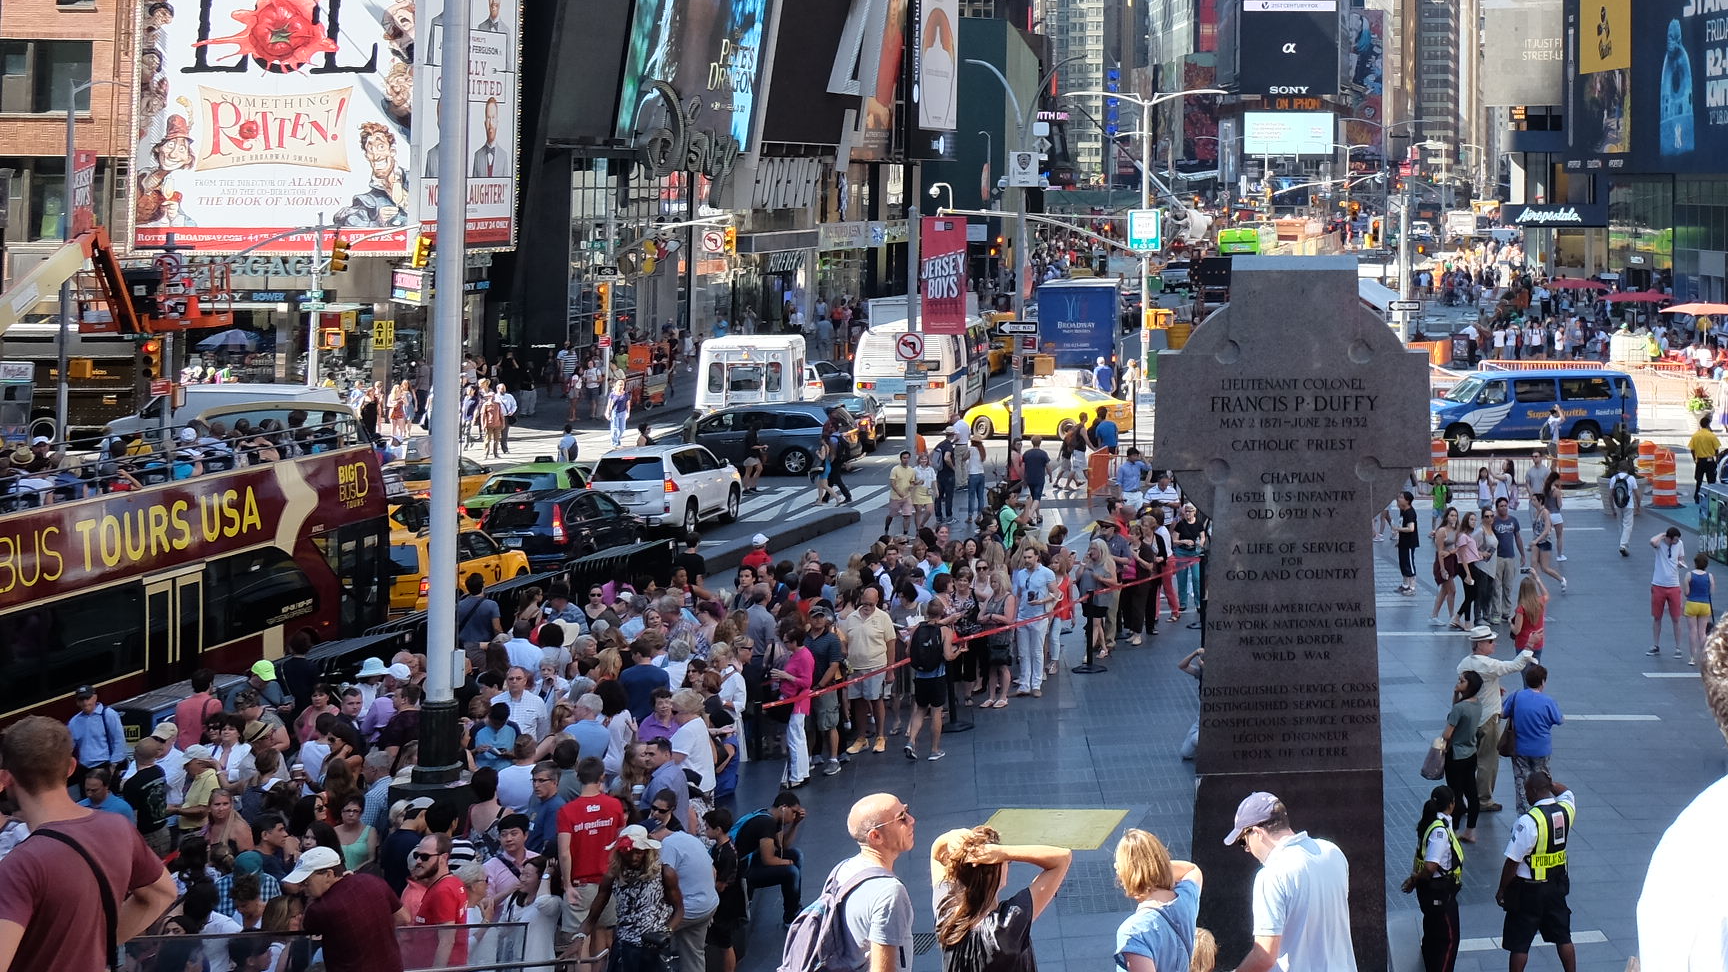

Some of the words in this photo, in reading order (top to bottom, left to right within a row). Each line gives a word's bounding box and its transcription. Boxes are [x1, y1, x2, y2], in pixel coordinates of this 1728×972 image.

[1270, 86, 1309, 94] SONY
[221, 93, 329, 107] SOMETHING
[288, 177, 344, 187] ALADDIN
[197, 197, 223, 206] THE
[227, 196, 263, 206] BOOK
[265, 196, 282, 206] OF
[284, 196, 342, 206] MORMON
[922, 253, 966, 279] JERSEY
[928, 276, 958, 299] BOYS
[375, 322, 384, 346] ATM
[1221, 379, 1300, 390] LIEUTENANT
[1303, 379, 1365, 389] COLONEL
[1210, 396, 1288, 412] FRANCIS
[1314, 396, 1378, 411] DUFFY
[1220, 417, 1244, 428] MAY
[1231, 440, 1299, 451] CATHOLIC
[1307, 439, 1356, 450] PRIEST
[339, 465, 355, 486] BIG
[1260, 472, 1325, 484] CHAPLAIN
[1247, 509, 1274, 520] OLD
[75, 500, 192, 572] TOURS
[200, 485, 262, 543] USA
[1247, 543, 1274, 555] LIFE
[1278, 543, 1294, 554] OF
[1301, 542, 1355, 554] SERVICE
[1281, 557, 1303, 566] FOR
[1226, 570, 1258, 581] GOD
[1260, 570, 1290, 581] AND
[1296, 569, 1359, 580] COUNTRY
[1222, 604, 1268, 614] SPANISH
[1272, 603, 1332, 613] AMERICAN
[1336, 602, 1362, 611] WAR
[1207, 621, 1232, 630] NEW
[1237, 620, 1268, 630] YORK
[1273, 619, 1330, 629] NATIONAL
[1334, 618, 1376, 628] GUARD
